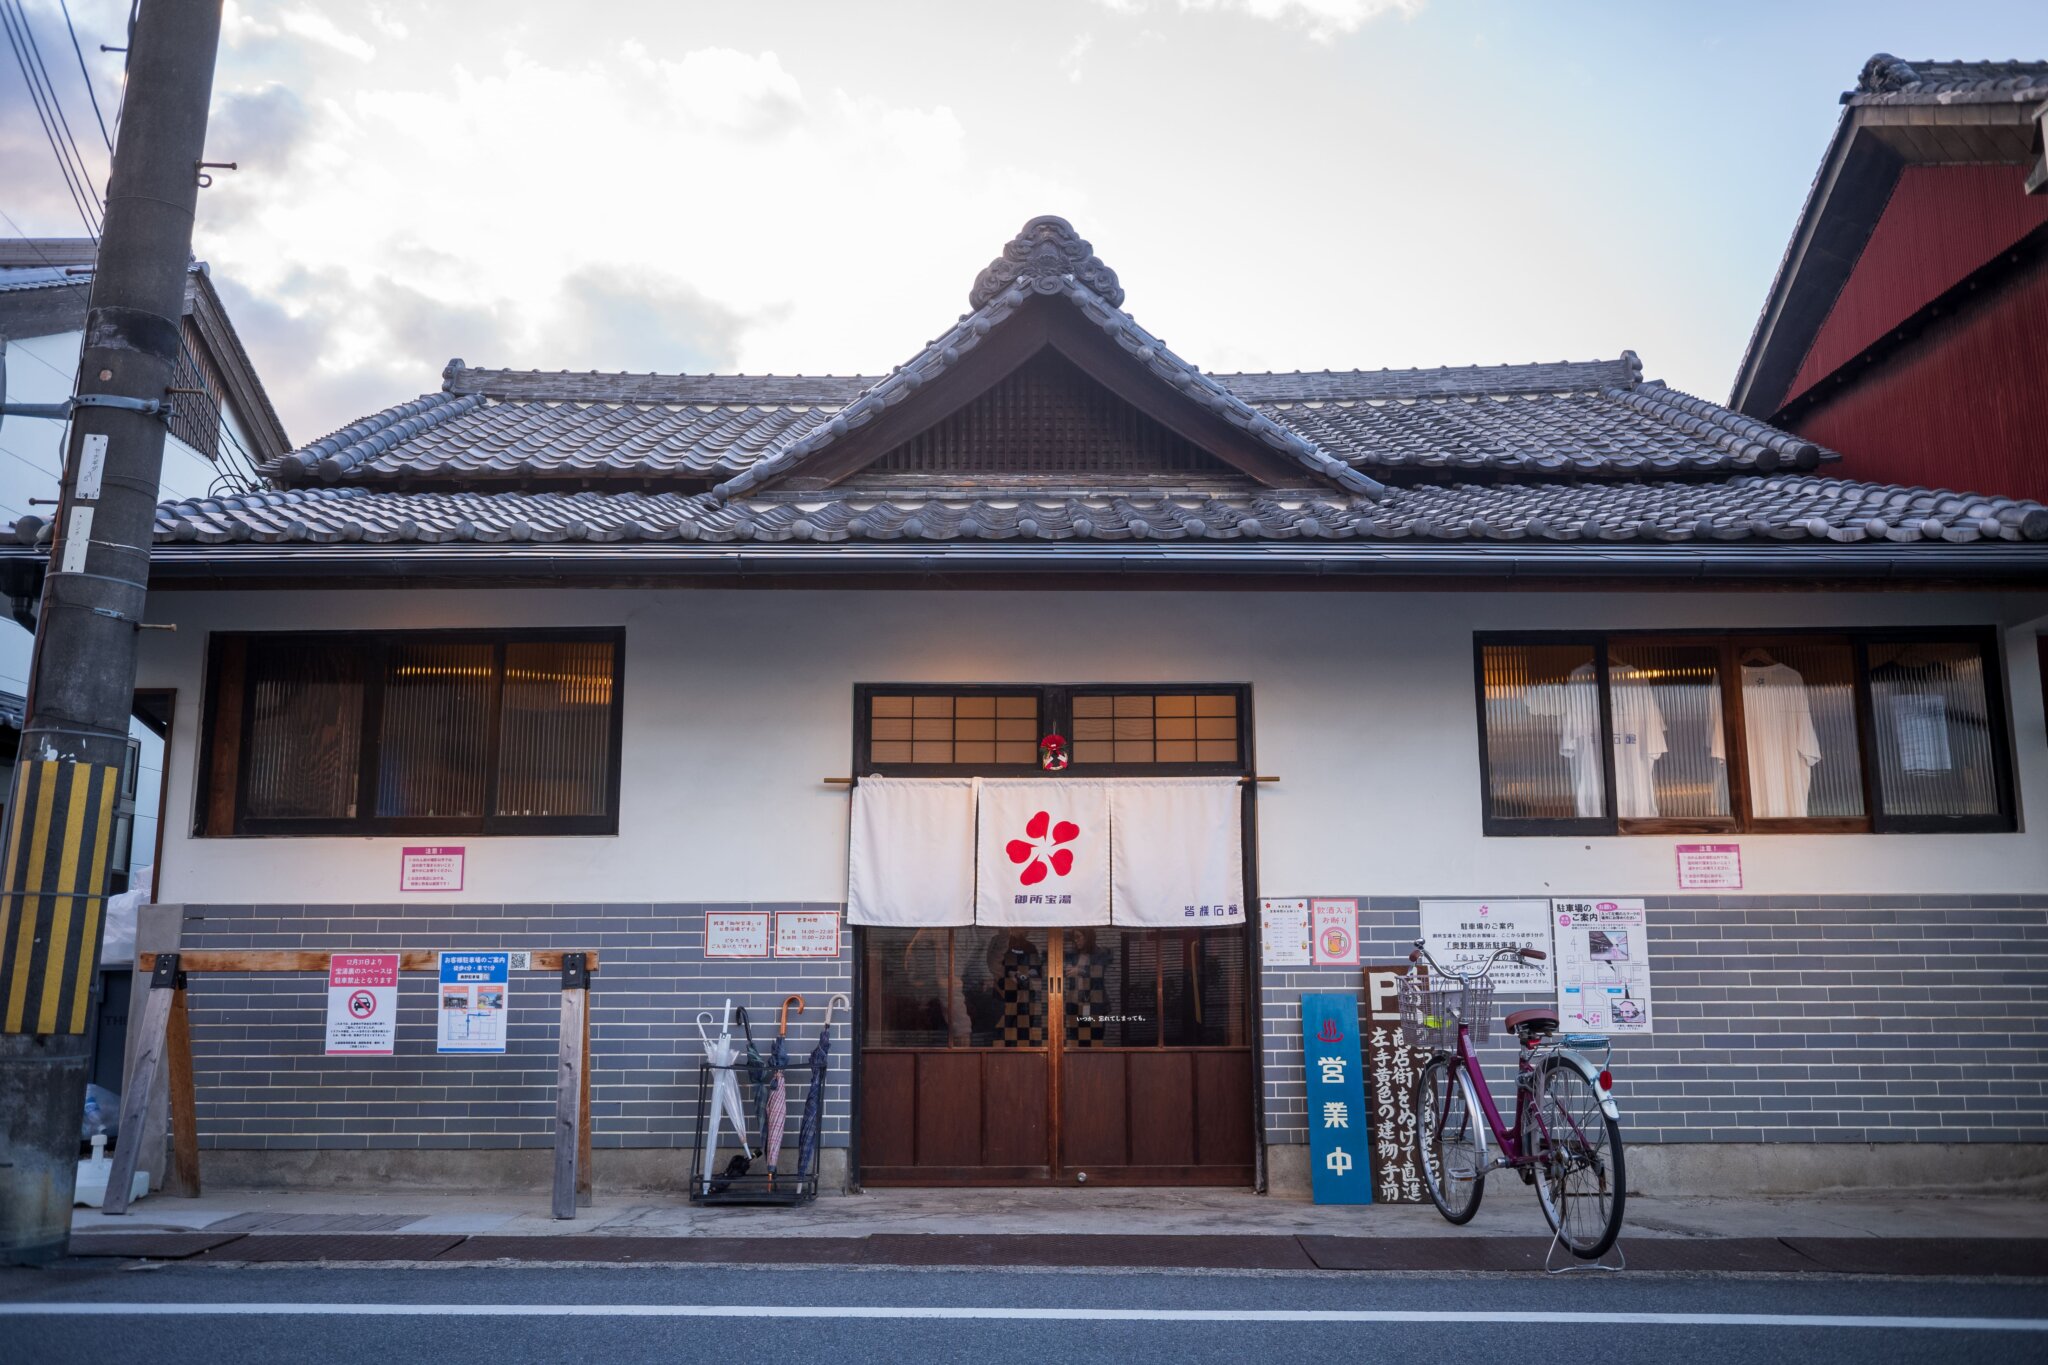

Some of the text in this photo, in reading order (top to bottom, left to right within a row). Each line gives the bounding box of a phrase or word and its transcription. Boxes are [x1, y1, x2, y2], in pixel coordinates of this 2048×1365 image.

[1014, 894, 1072, 904] 御所宝湯
[1316, 906, 1353, 914] 飲酒入浴
[1556, 904, 1592, 912] 駐車場の
[1322, 916, 1347, 924] お断り
[1572, 913, 1598, 922] ご案内
[1460, 922, 1515, 930] 駐車場のご案内
[444, 956, 506, 964] お客様駐車場のご案内
[1369, 971, 1400, 1011] P
[1076, 1014, 1147, 1022] いつか、忘れてしまっても。
[1317, 1055, 1353, 1177] 営業中
[1370, 1026, 1400, 1202] 左手黄色の建物手前
